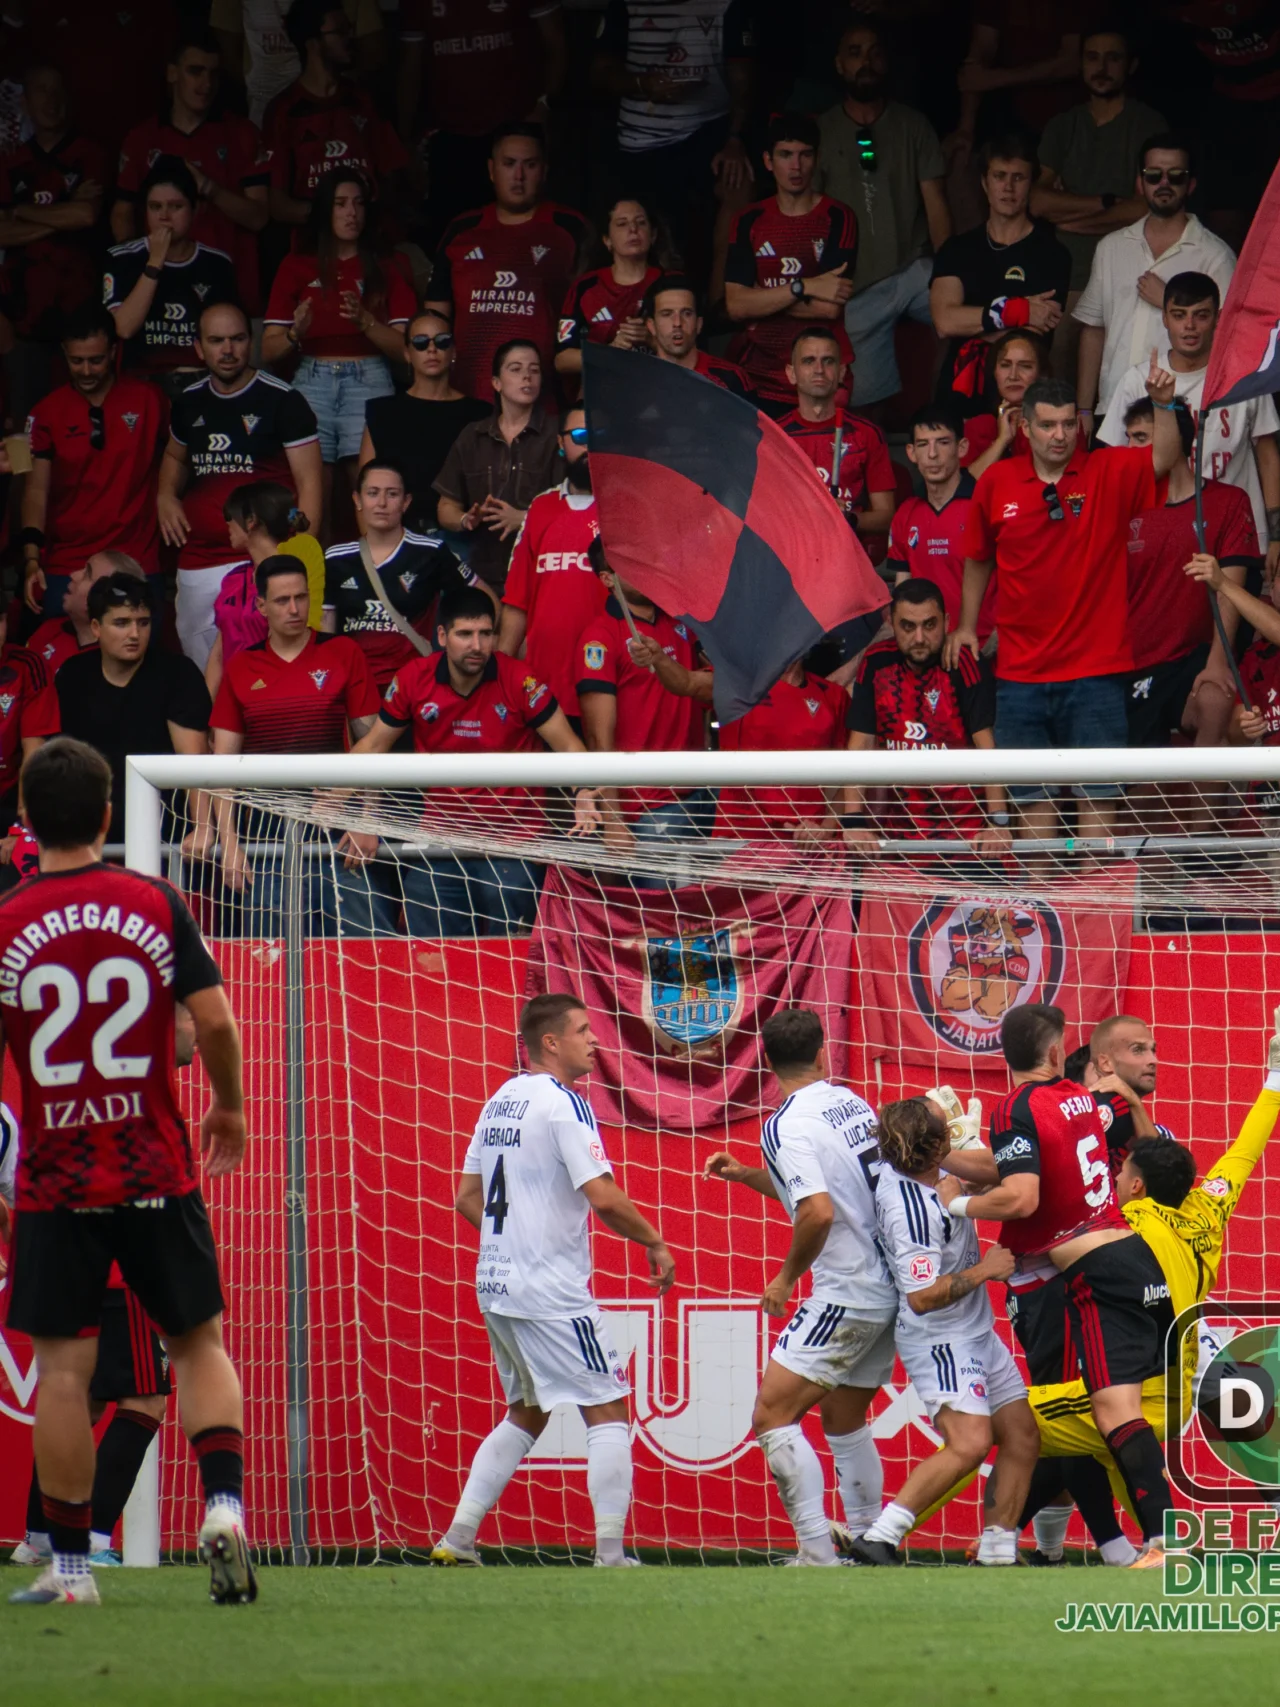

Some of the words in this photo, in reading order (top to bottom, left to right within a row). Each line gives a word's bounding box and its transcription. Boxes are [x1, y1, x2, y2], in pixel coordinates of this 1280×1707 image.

[469, 302, 536, 316] EMPRESAS
[470, 289, 537, 303] MIRANDA
[0, 902, 177, 1008] AGUIRREGABIRIA
[19, 956, 153, 1088] 22
[41, 1091, 144, 1130] IZADI
[1060, 1095, 1094, 1121] PERU
[484, 1153, 509, 1235] 4
[1075, 1133, 1110, 1209] 5
